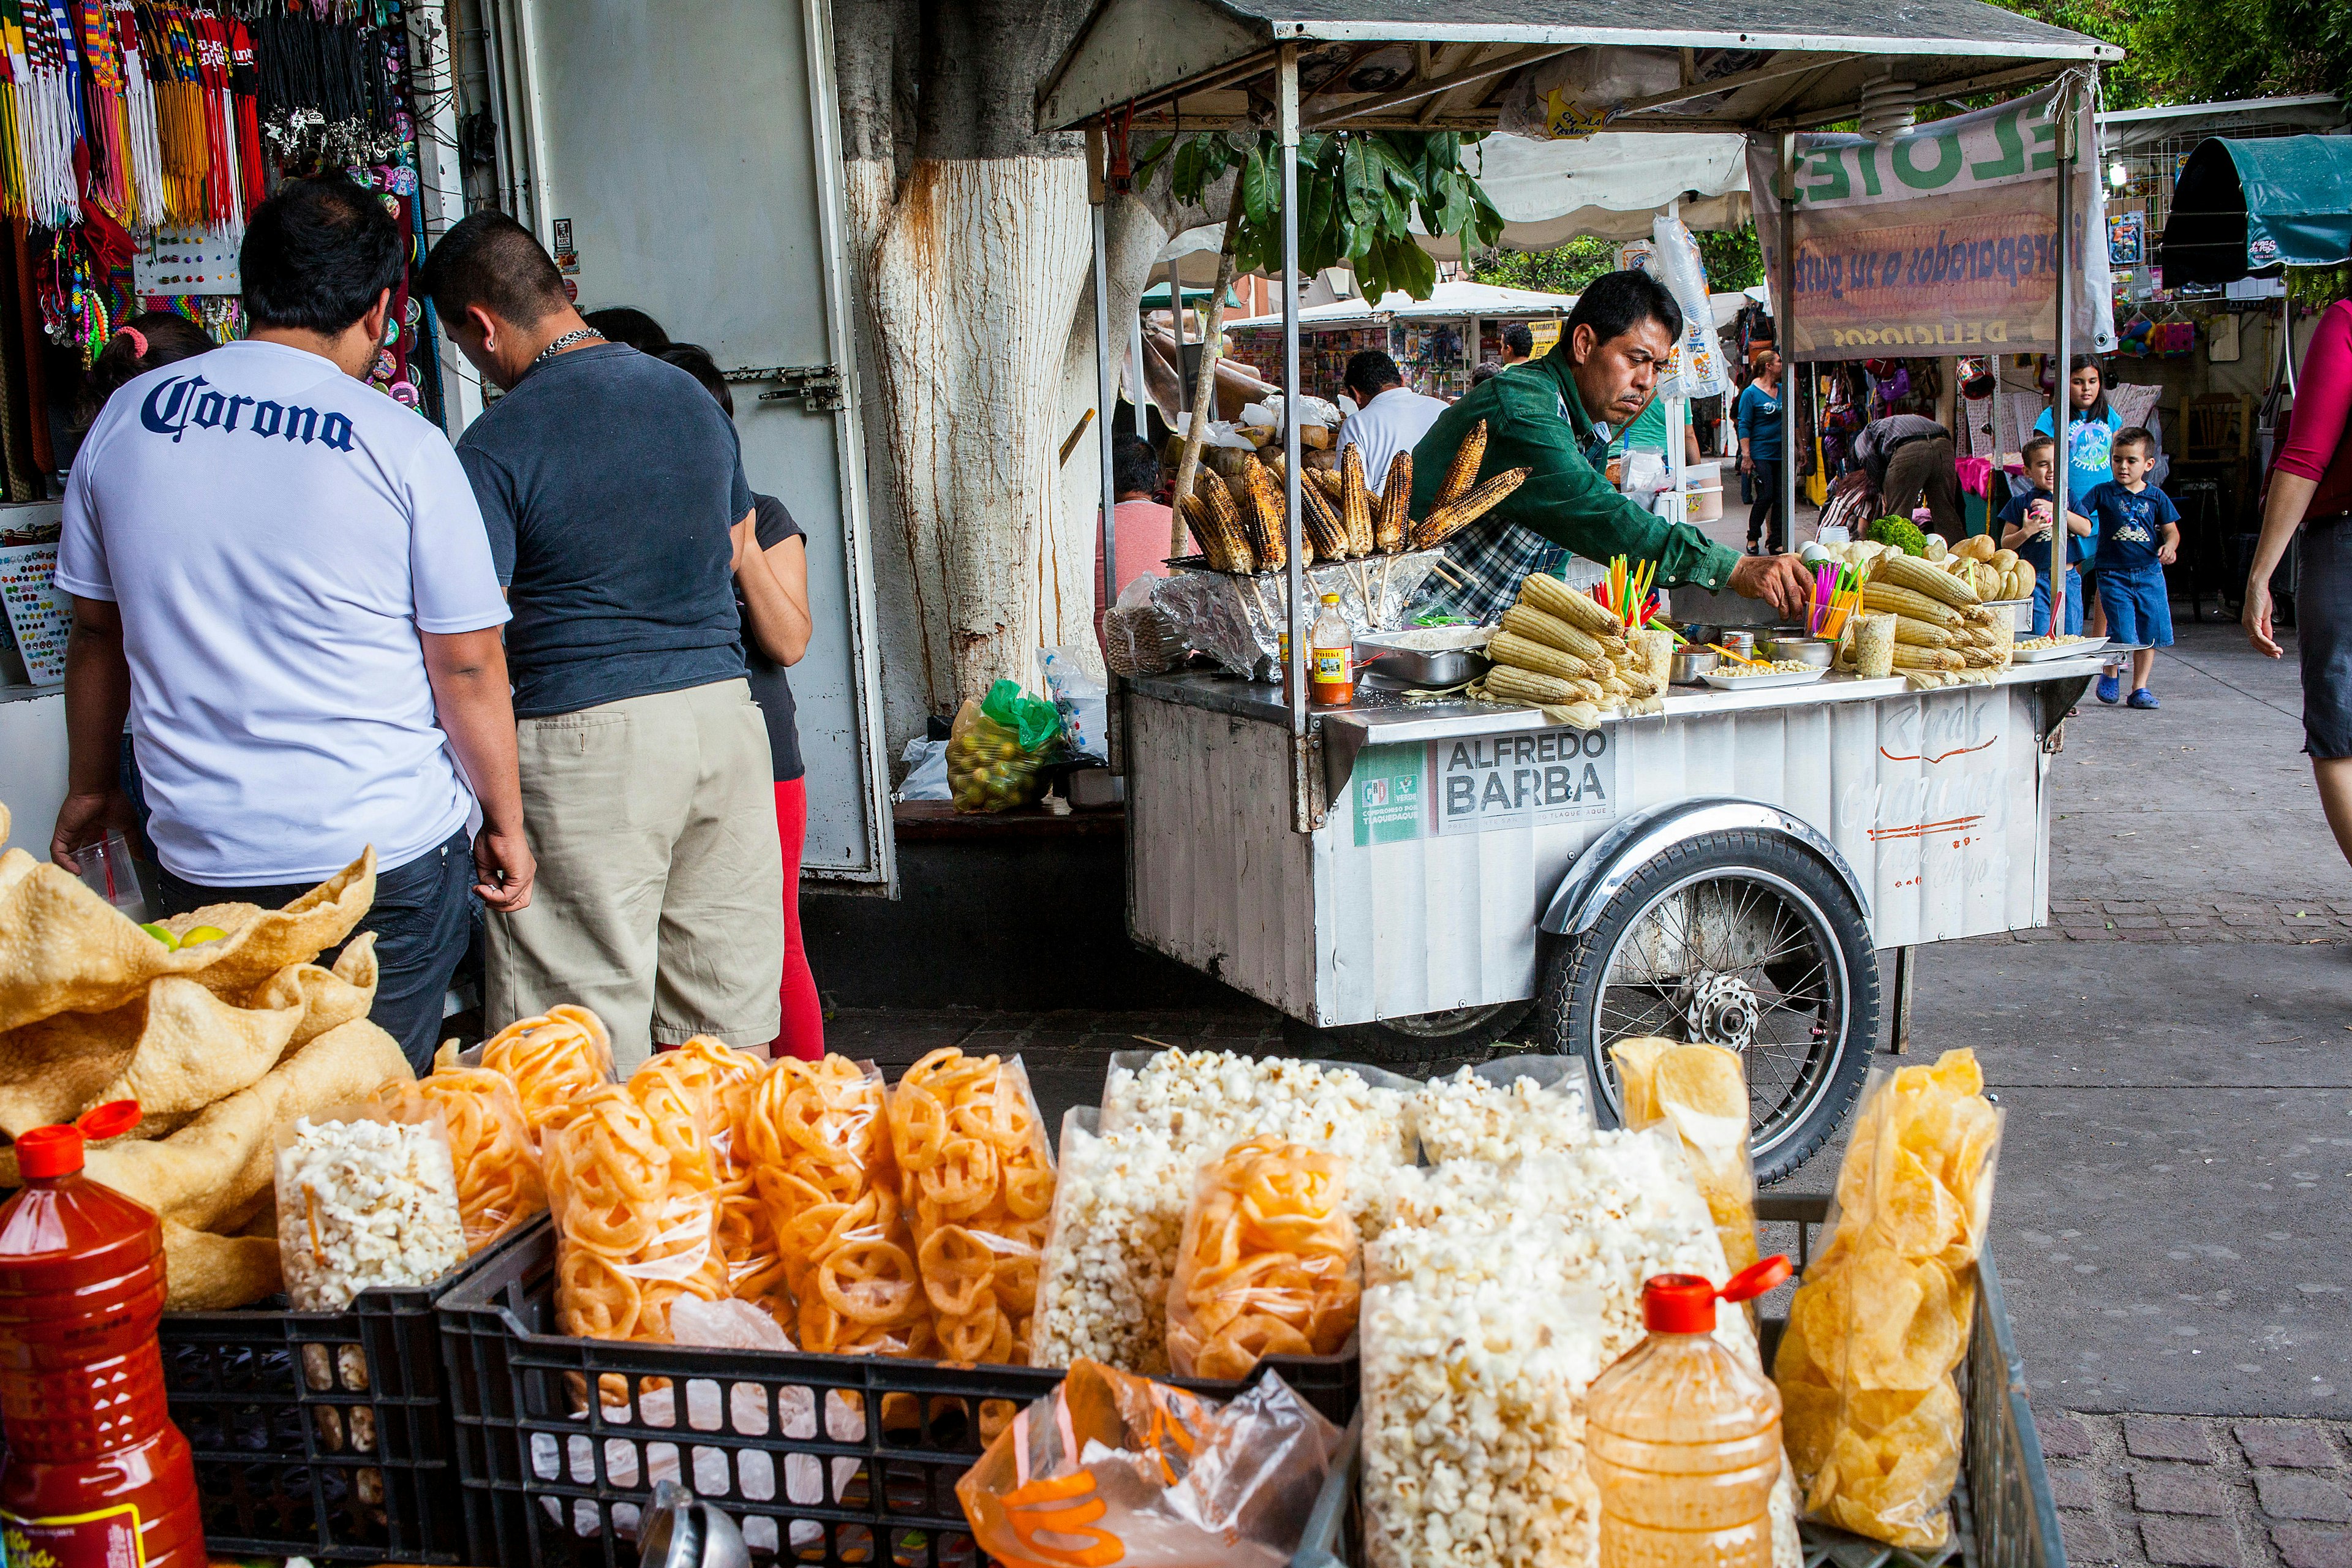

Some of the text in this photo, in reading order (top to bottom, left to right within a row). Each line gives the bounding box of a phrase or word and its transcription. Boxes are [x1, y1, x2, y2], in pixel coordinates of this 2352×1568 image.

[140, 374, 355, 453] Corona
[2070, 456, 2099, 472] TOTAL
[1447, 729, 1607, 771] ALFREDO
[1447, 763, 1605, 815] BARBA
[1362, 806, 1403, 817] COMPROMISO
[1363, 811, 1419, 824] TLAQUEPAQUE
[1550, 808, 1607, 819] TLAQUEAQUE
